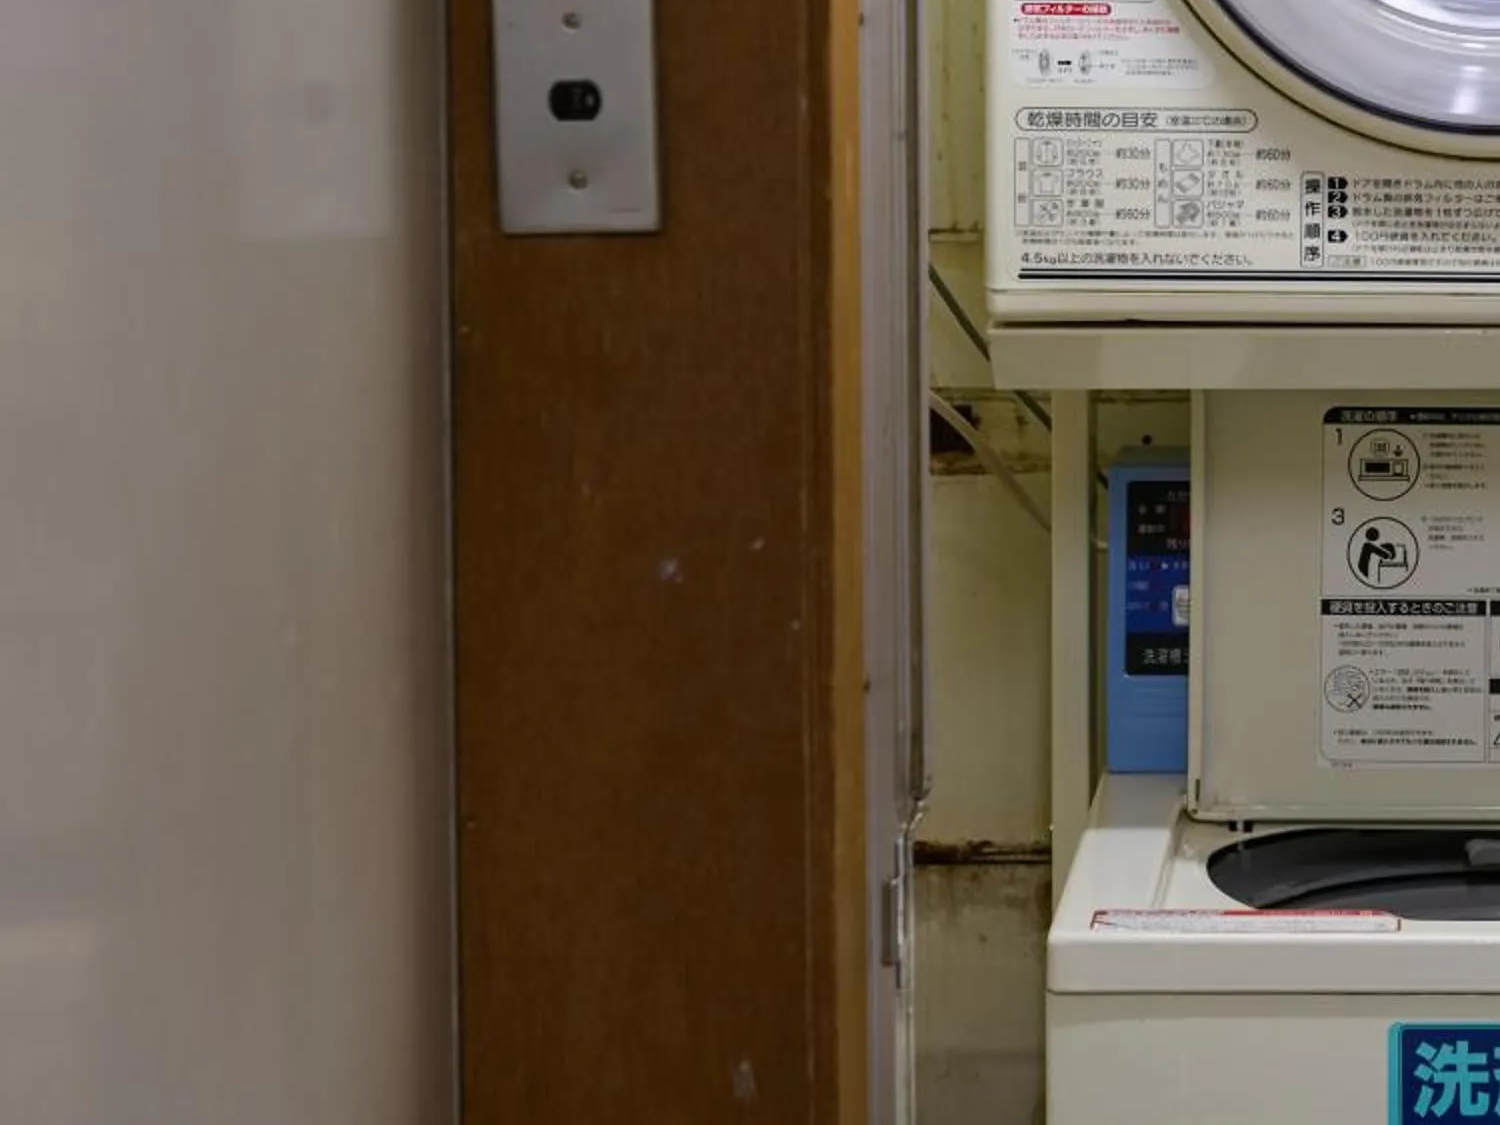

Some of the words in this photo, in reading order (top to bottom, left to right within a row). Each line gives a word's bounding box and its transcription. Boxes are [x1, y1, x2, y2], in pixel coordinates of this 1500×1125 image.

[1027, 111, 1158, 127] 乾燥時間の目安
[1335, 428, 1343, 445] 1
[1331, 508, 1345, 525] 3
